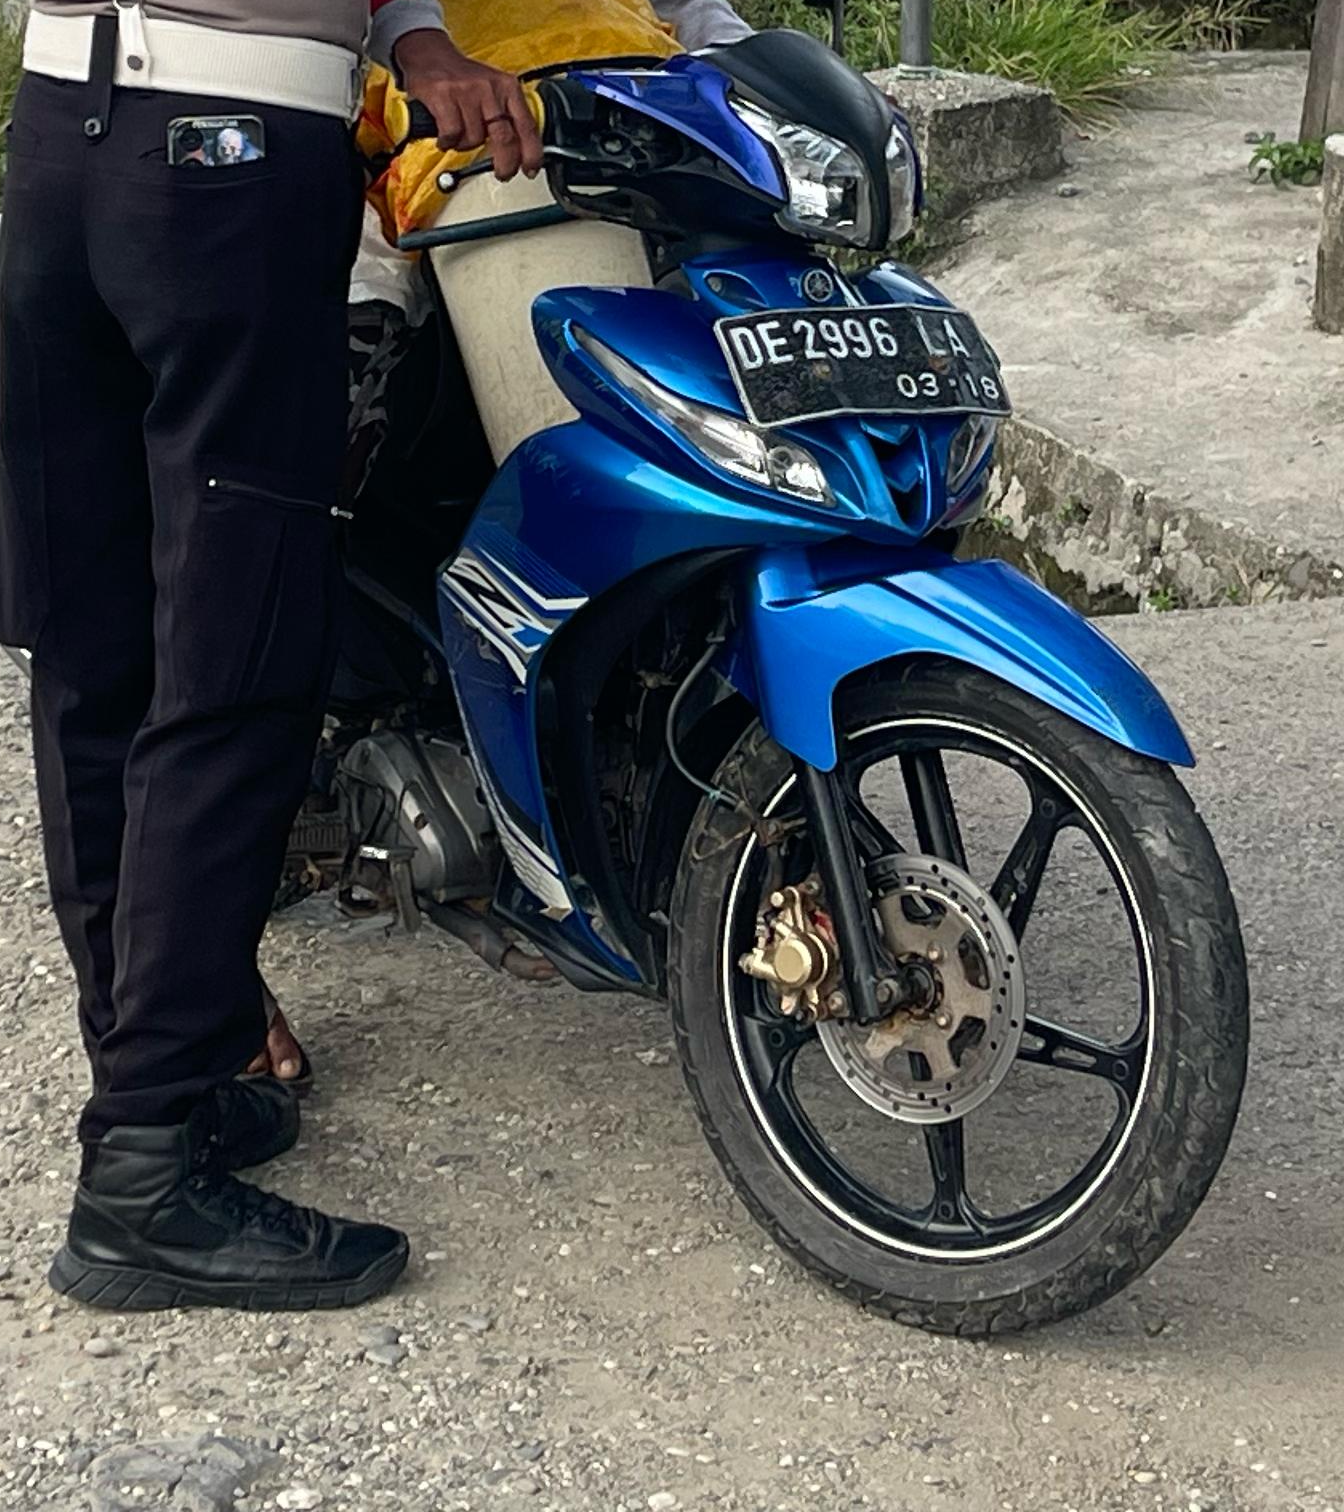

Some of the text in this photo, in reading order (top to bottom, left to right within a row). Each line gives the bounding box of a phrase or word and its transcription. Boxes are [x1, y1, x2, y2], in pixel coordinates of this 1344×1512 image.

[729, 315, 971, 371] DE 2996 LA
